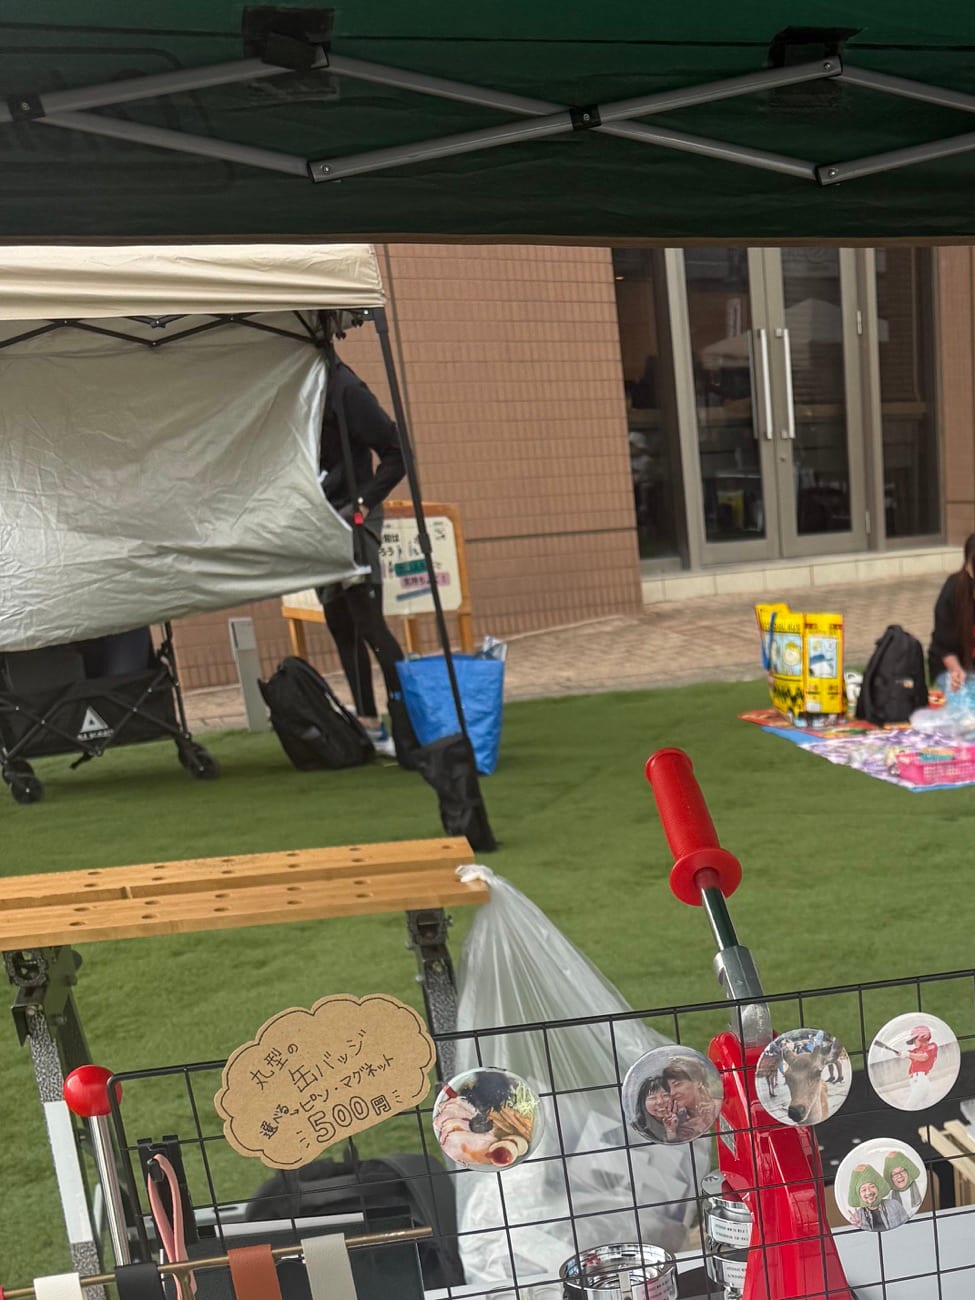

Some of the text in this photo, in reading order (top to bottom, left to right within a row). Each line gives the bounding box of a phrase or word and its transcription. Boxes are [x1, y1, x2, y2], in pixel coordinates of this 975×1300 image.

[249, 1042, 299, 1091] 丸型の
[288, 1029, 368, 1094] 缶バッジ
[307, 1093, 392, 1143] 500円
